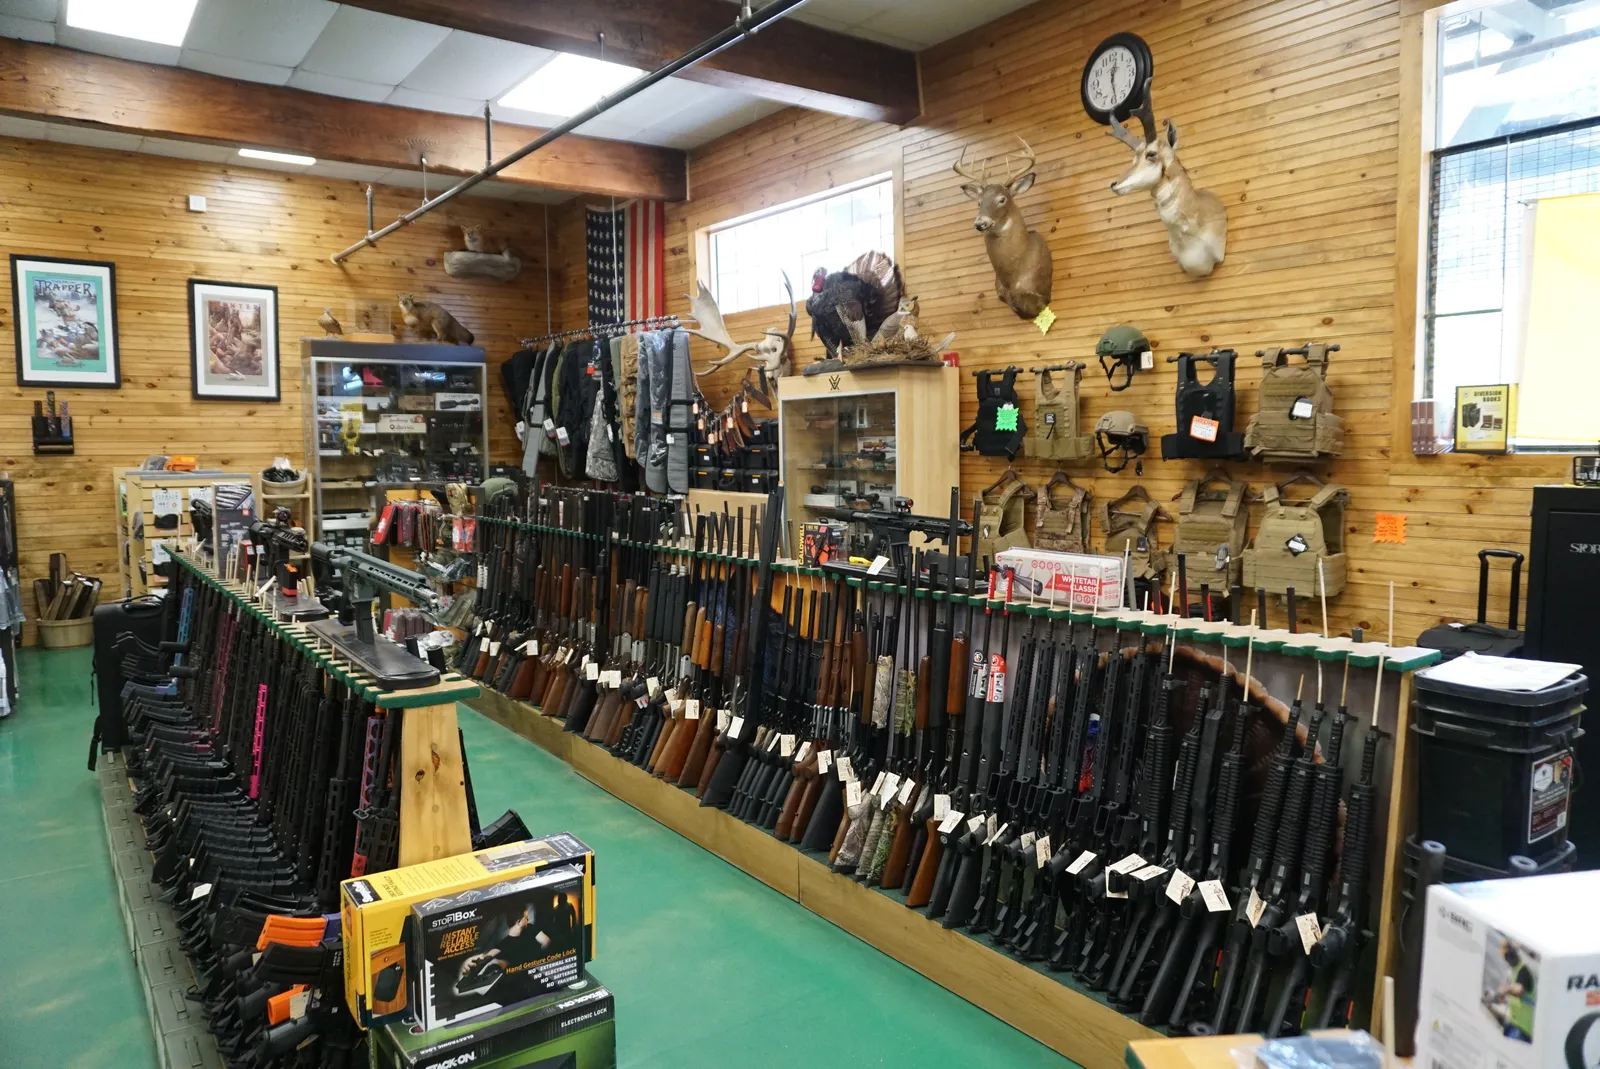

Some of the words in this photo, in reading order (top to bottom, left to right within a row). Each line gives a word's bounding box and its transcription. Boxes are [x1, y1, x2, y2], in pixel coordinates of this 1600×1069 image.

[1109, 51, 1118, 62] 12
[1102, 58, 1108, 67] 11
[1126, 58, 1132, 68] 2
[1095, 68, 1103, 78] 10
[1129, 68, 1135, 77] 3
[1093, 79, 1100, 90] 9
[1126, 78, 1131, 88] 4
[1096, 88, 1103, 99] 8
[1120, 89, 1126, 99] 5
[1102, 94, 1108, 107] 7
[1111, 95, 1117, 104] 6
[34, 280, 95, 298] TRAPPER
[443, 926, 478, 941] INSTANT
[440, 932, 480, 949] RELIABLE
[444, 942, 475, 955] ACCESS
[506, 963, 522, 974] Hand
[523, 958, 546, 969] Gesture
[547, 953, 562, 962] Code
[563, 948, 577, 957] Lock
[540, 960, 564, 971] EXTERNAL
[565, 955, 577, 963] KEYS
[545, 962, 577, 977] ELECTRONICS
[554, 969, 577, 980] BATTERIES
[558, 974, 578, 985] FAILURES
[561, 1013, 593, 1028] ELECTRONIC
[594, 1007, 608, 1017] LOCK
